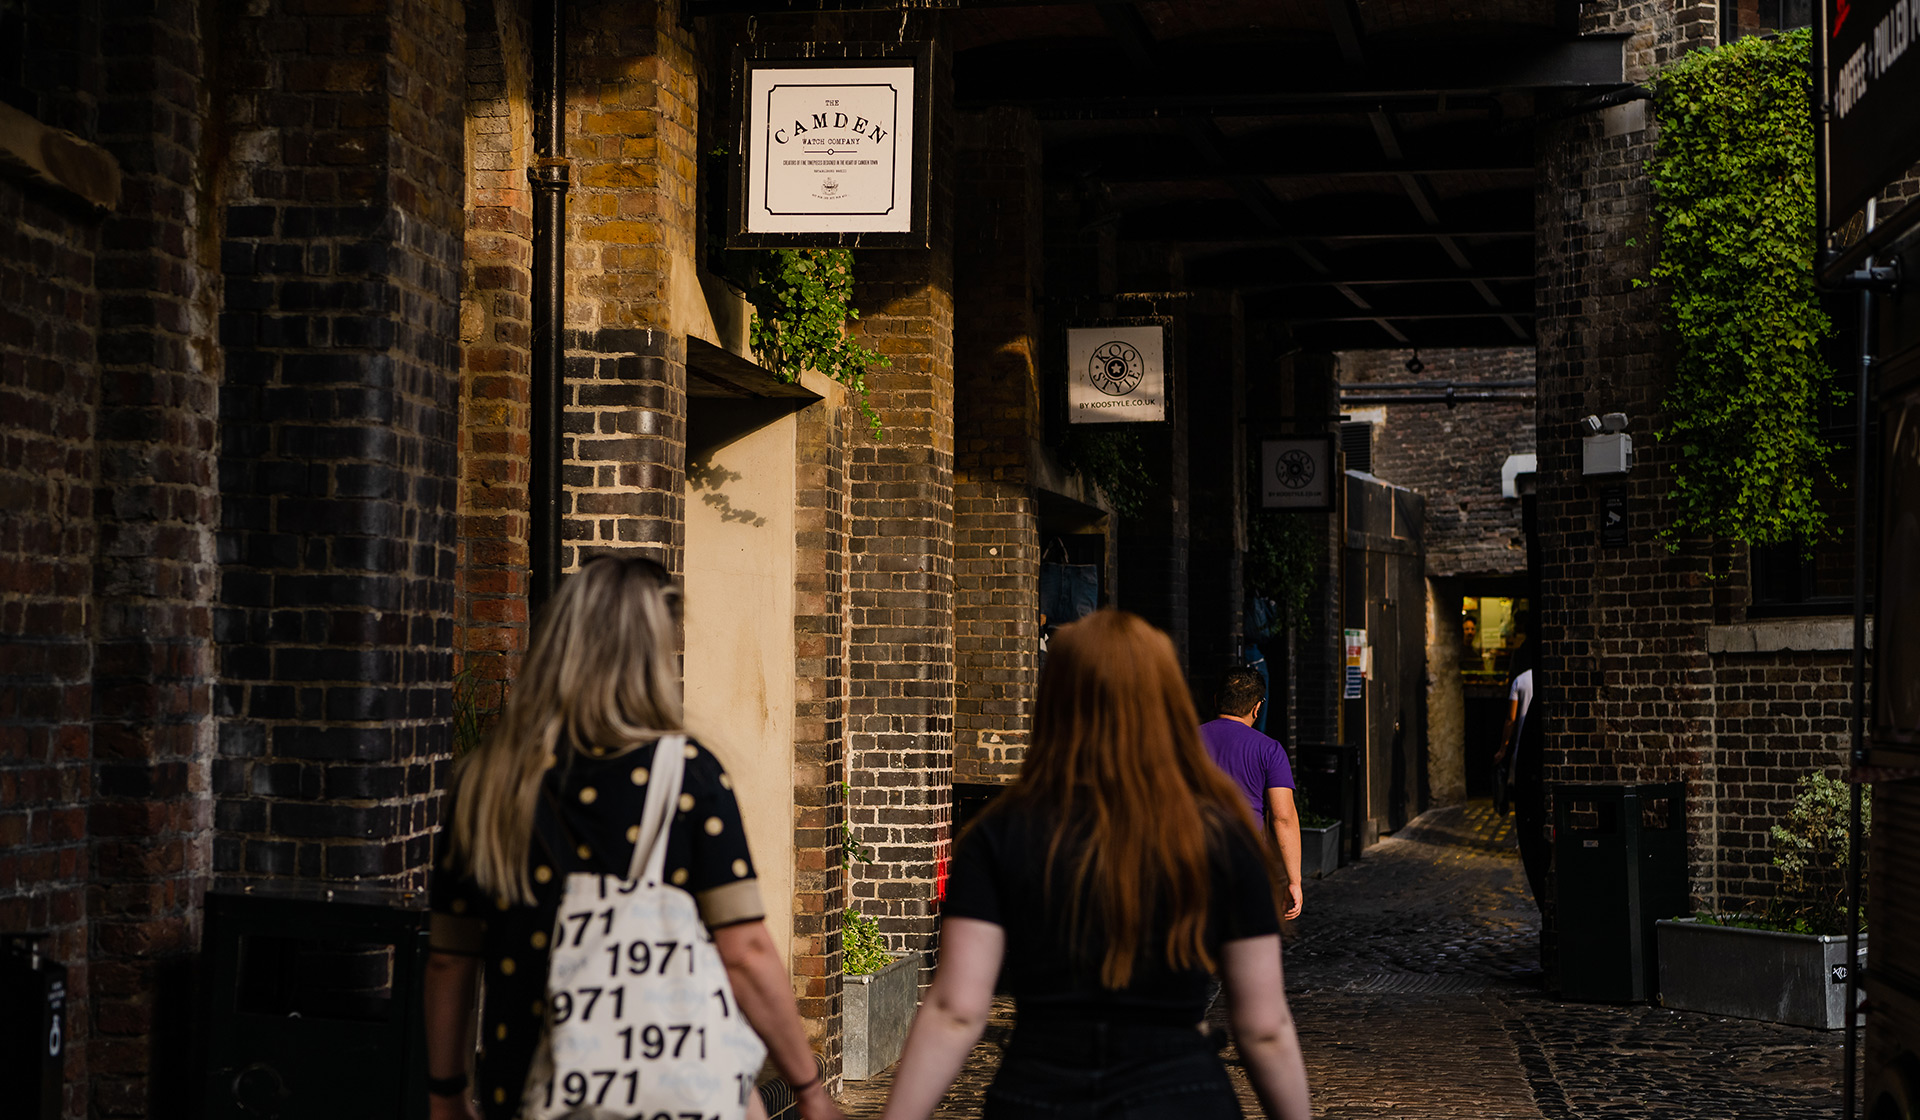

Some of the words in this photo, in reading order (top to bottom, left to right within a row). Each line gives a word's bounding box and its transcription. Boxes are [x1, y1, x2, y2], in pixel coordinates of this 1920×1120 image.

[1839, 42, 1867, 118] COFFEE
[1874, 0, 1908, 79] PULLED
[825, 99, 840, 107] THE
[774, 112, 888, 145] CAMDEN
[1095, 344, 1136, 364] KOO
[1093, 370, 1140, 393] STYLE
[1091, 399, 1156, 409] KOOSTYLE.CO.UK
[606, 940, 695, 977] 1971
[617, 1025, 706, 1060] 1971
